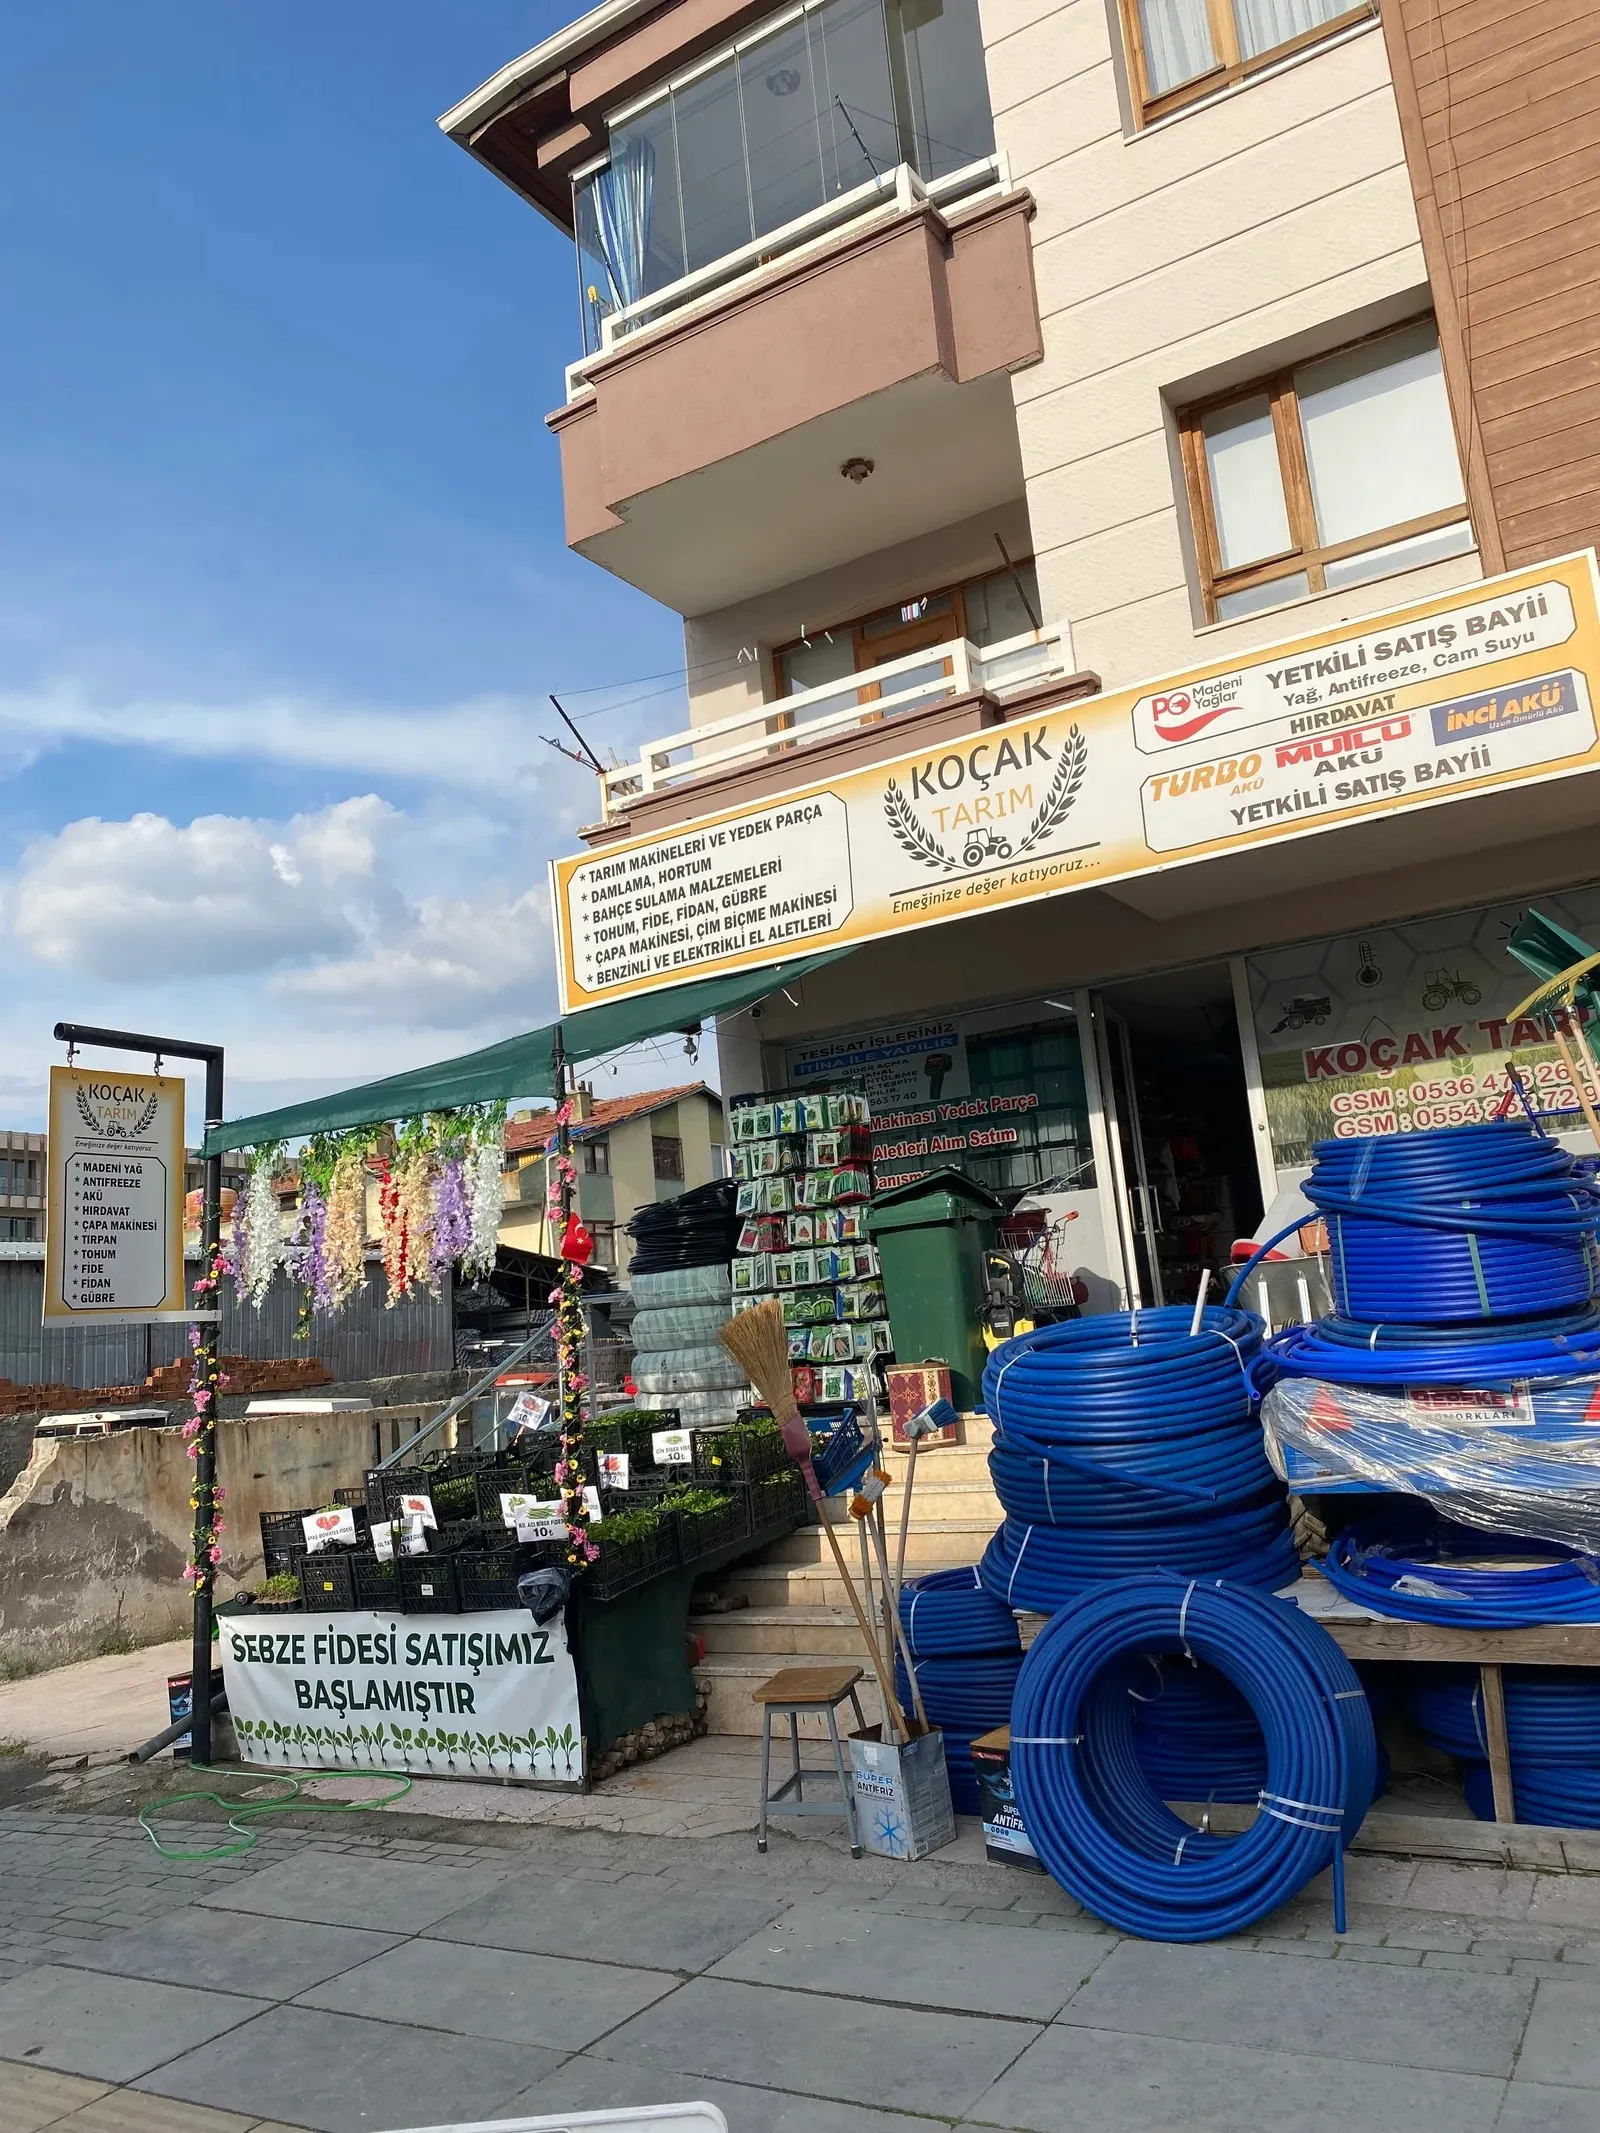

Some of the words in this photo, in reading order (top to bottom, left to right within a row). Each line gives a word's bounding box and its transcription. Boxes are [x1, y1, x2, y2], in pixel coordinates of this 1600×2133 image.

[1266, 644, 1367, 690] YETKİLİ
[1374, 624, 1457, 661] SATIŞ
[1466, 592, 1548, 637] BAYİİ
[1192, 675, 1243, 699] Madeni
[1283, 687, 1323, 707] Yağ,
[1329, 663, 1427, 696] Antifreeze,
[1433, 647, 1479, 667] Cam
[1485, 631, 1535, 654] Suyu
[1194, 691, 1237, 709] Yağlar
[1290, 694, 1395, 734] HIRDAVAT
[1489, 719, 1512, 731] Uzun
[1513, 708, 1544, 725] Ömürlü
[1545, 704, 1564, 716] Akü
[1501, 682, 1561, 718] AKÜ
[1275, 715, 1412, 768] MUTLU
[911, 725, 1053, 800] KOÇAK
[1150, 754, 1262, 801] TURBO
[1314, 747, 1383, 778] AKÜ
[1230, 783, 1327, 826] YETKİLİ
[1335, 769, 1406, 801] SATIŞ
[1414, 744, 1491, 783] BAYİİ
[1231, 777, 1264, 796] AKÜ
[932, 783, 1034, 833] TARIM
[589, 861, 626, 883] TARIM
[629, 834, 706, 872] MAKİNELERİ
[709, 832, 726, 848] VE
[729, 818, 772, 842] YEDEK
[776, 804, 822, 829] PARÇA
[591, 875, 655, 903] DAMLAMA,
[659, 857, 712, 883] HORTUM
[593, 901, 632, 924] BAHÇE
[635, 886, 686, 911] SULAMA
[690, 855, 782, 897] MALZEMELERİ
[893, 888, 962, 914] Emeğinize
[966, 877, 1006, 895] değer
[1010, 858, 1101, 886] katıyoruz...
[594, 920, 639, 944] TOHUM,
[642, 911, 673, 931] FİDE,
[676, 899, 719, 922] FİDAN,
[722, 885, 767, 909] GÜBRE
[595, 945, 626, 968] ÇAPA
[629, 924, 693, 955] MAKİNESİ,
[696, 918, 720, 940] ÇİM
[724, 907, 766, 930] BİÇME
[769, 884, 837, 918] MAKİNESİ
[597, 955, 651, 985] BENZİNLİ
[654, 953, 670, 969] VE
[673, 930, 745, 964] ELEKTRİKLİ
[749, 929, 765, 945] EL
[768, 908, 832, 940] ALETLERİ
[799, 1040, 866, 1061] TESİSAT
[869, 1023, 955, 1047] İŞLERİNİZ
[800, 1059, 845, 1074] İTİNA
[850, 1051, 876, 1064] İLE
[881, 1037, 954, 1058] YAPILIR
[1305, 1025, 1469, 1079] KOÇAK
[842, 1064, 875, 1076] GİDER
[876, 1058, 910, 1069] AÇMA
[88, 1083, 146, 1106] KOÇAK
[869, 1095, 888, 1106] 563
[890, 1094, 900, 1104] 17
[903, 1091, 917, 1100] 40
[1334, 1090, 1391, 1113] GSM
[1413, 1077, 1475, 1101] 0536
[1538, 1064, 1570, 1083] 26
[96, 1105, 137, 1121] TARIM
[870, 1109, 935, 1131] Makinası
[939, 1098, 988, 1119] Yedek
[990, 1093, 1039, 1112] Parça
[1337, 1114, 1394, 1137] GSM
[1416, 1102, 1479, 1127] 0554
[1543, 1088, 1576, 1109] 72
[75, 1141, 105, 1150] Emeğinize
[106, 1142, 123, 1151] değer
[873, 1141, 928, 1161] Aletleri
[930, 1134, 966, 1151] Alım
[969, 1127, 1018, 1147] Satım
[82, 1177, 141, 1189] ANTIFREEZE
[83, 1160, 122, 1176] MADENİ
[123, 1161, 143, 1176] YAĞ
[82, 1189, 103, 1202] AKÜ
[82, 1205, 130, 1217] HIRDAVAT
[82, 1220, 108, 1234] ÇAPA
[110, 1217, 157, 1231] MAKİNESİ
[82, 1234, 117, 1246] TIRPAN
[81, 1248, 116, 1260] TOHUM
[81, 1262, 104, 1275] FİDE
[81, 1276, 111, 1289] FİDAN
[81, 1290, 115, 1304] GÜBRE
[231, 1633, 306, 1665] SEBZE
[314, 1623, 397, 1665] FİDESİ
[405, 1630, 555, 1676] SATIŞIMIZ
[294, 1679, 477, 1722] BAŞLAMIŞTIR
[856, 1771, 893, 1785] SUPER
[992, 1813, 1026, 1831] ANTİFR
